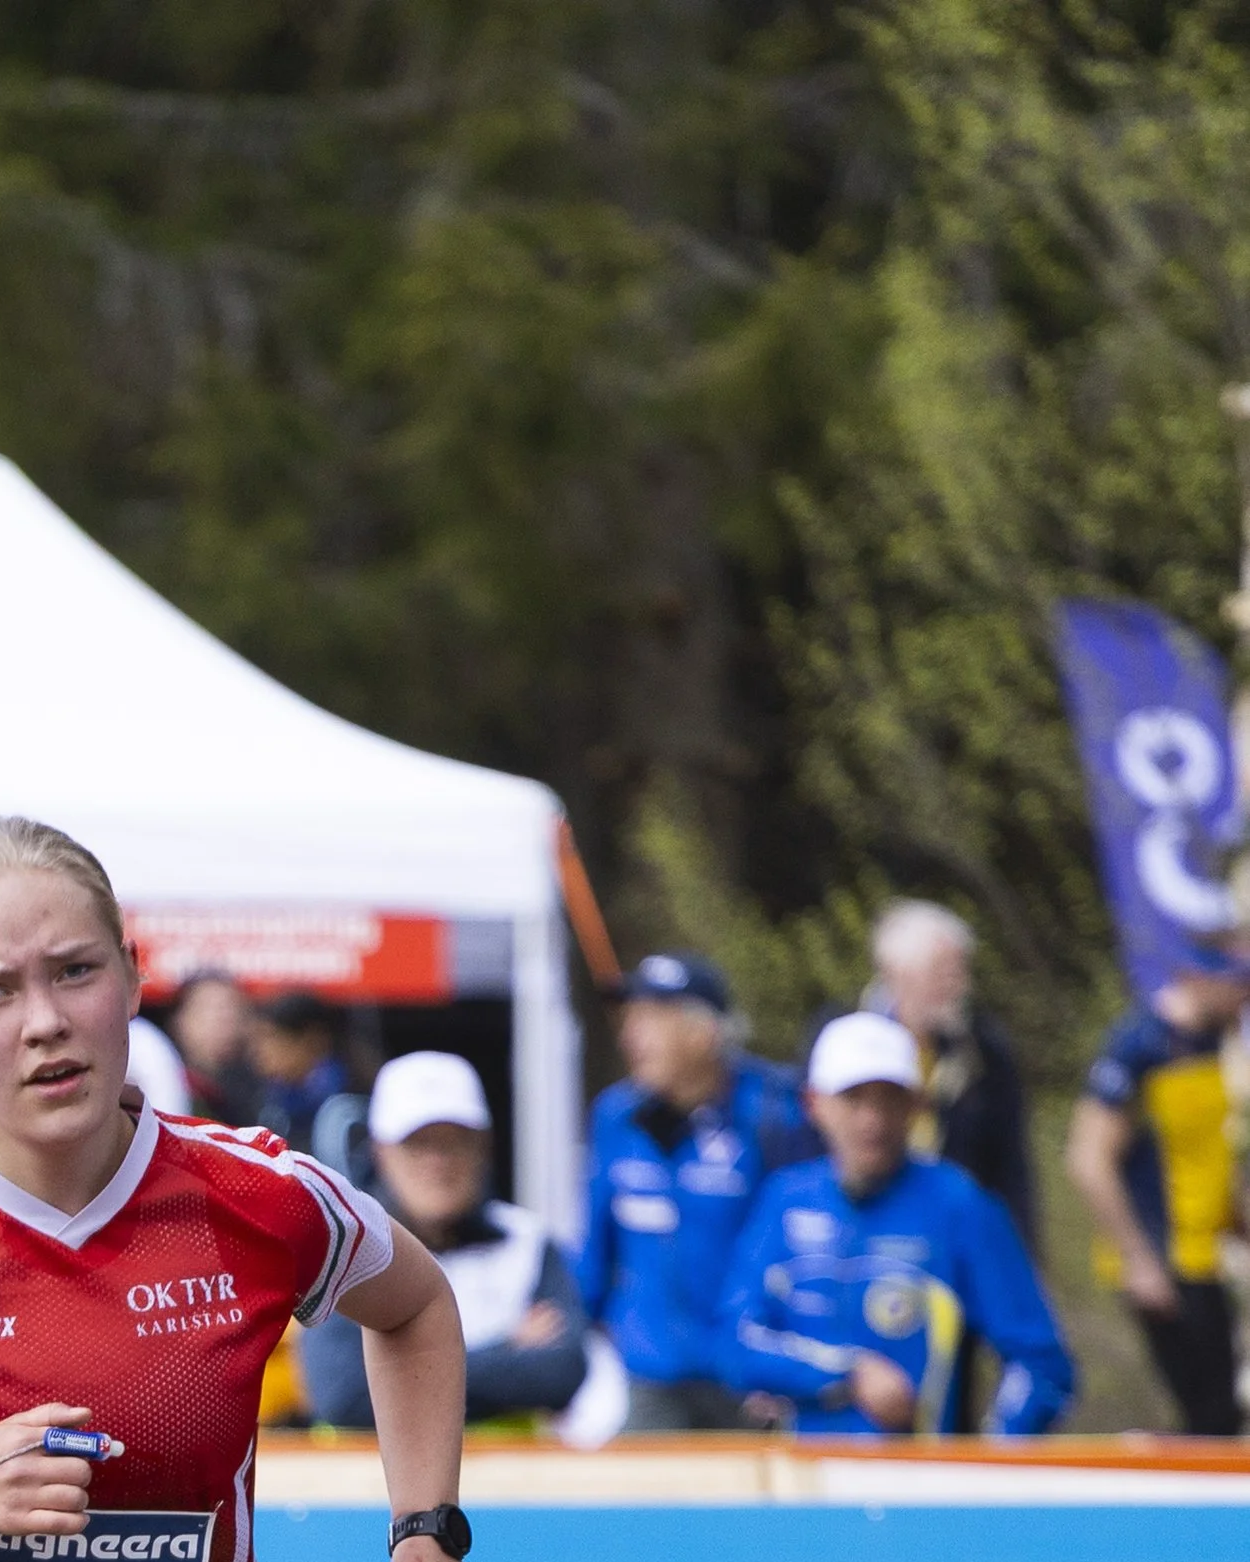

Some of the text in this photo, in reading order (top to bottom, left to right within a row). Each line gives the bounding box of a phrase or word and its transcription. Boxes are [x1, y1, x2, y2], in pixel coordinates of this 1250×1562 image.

[126, 1273, 239, 1313] OK TYR
[136, 1307, 244, 1338] KARLSTAD
